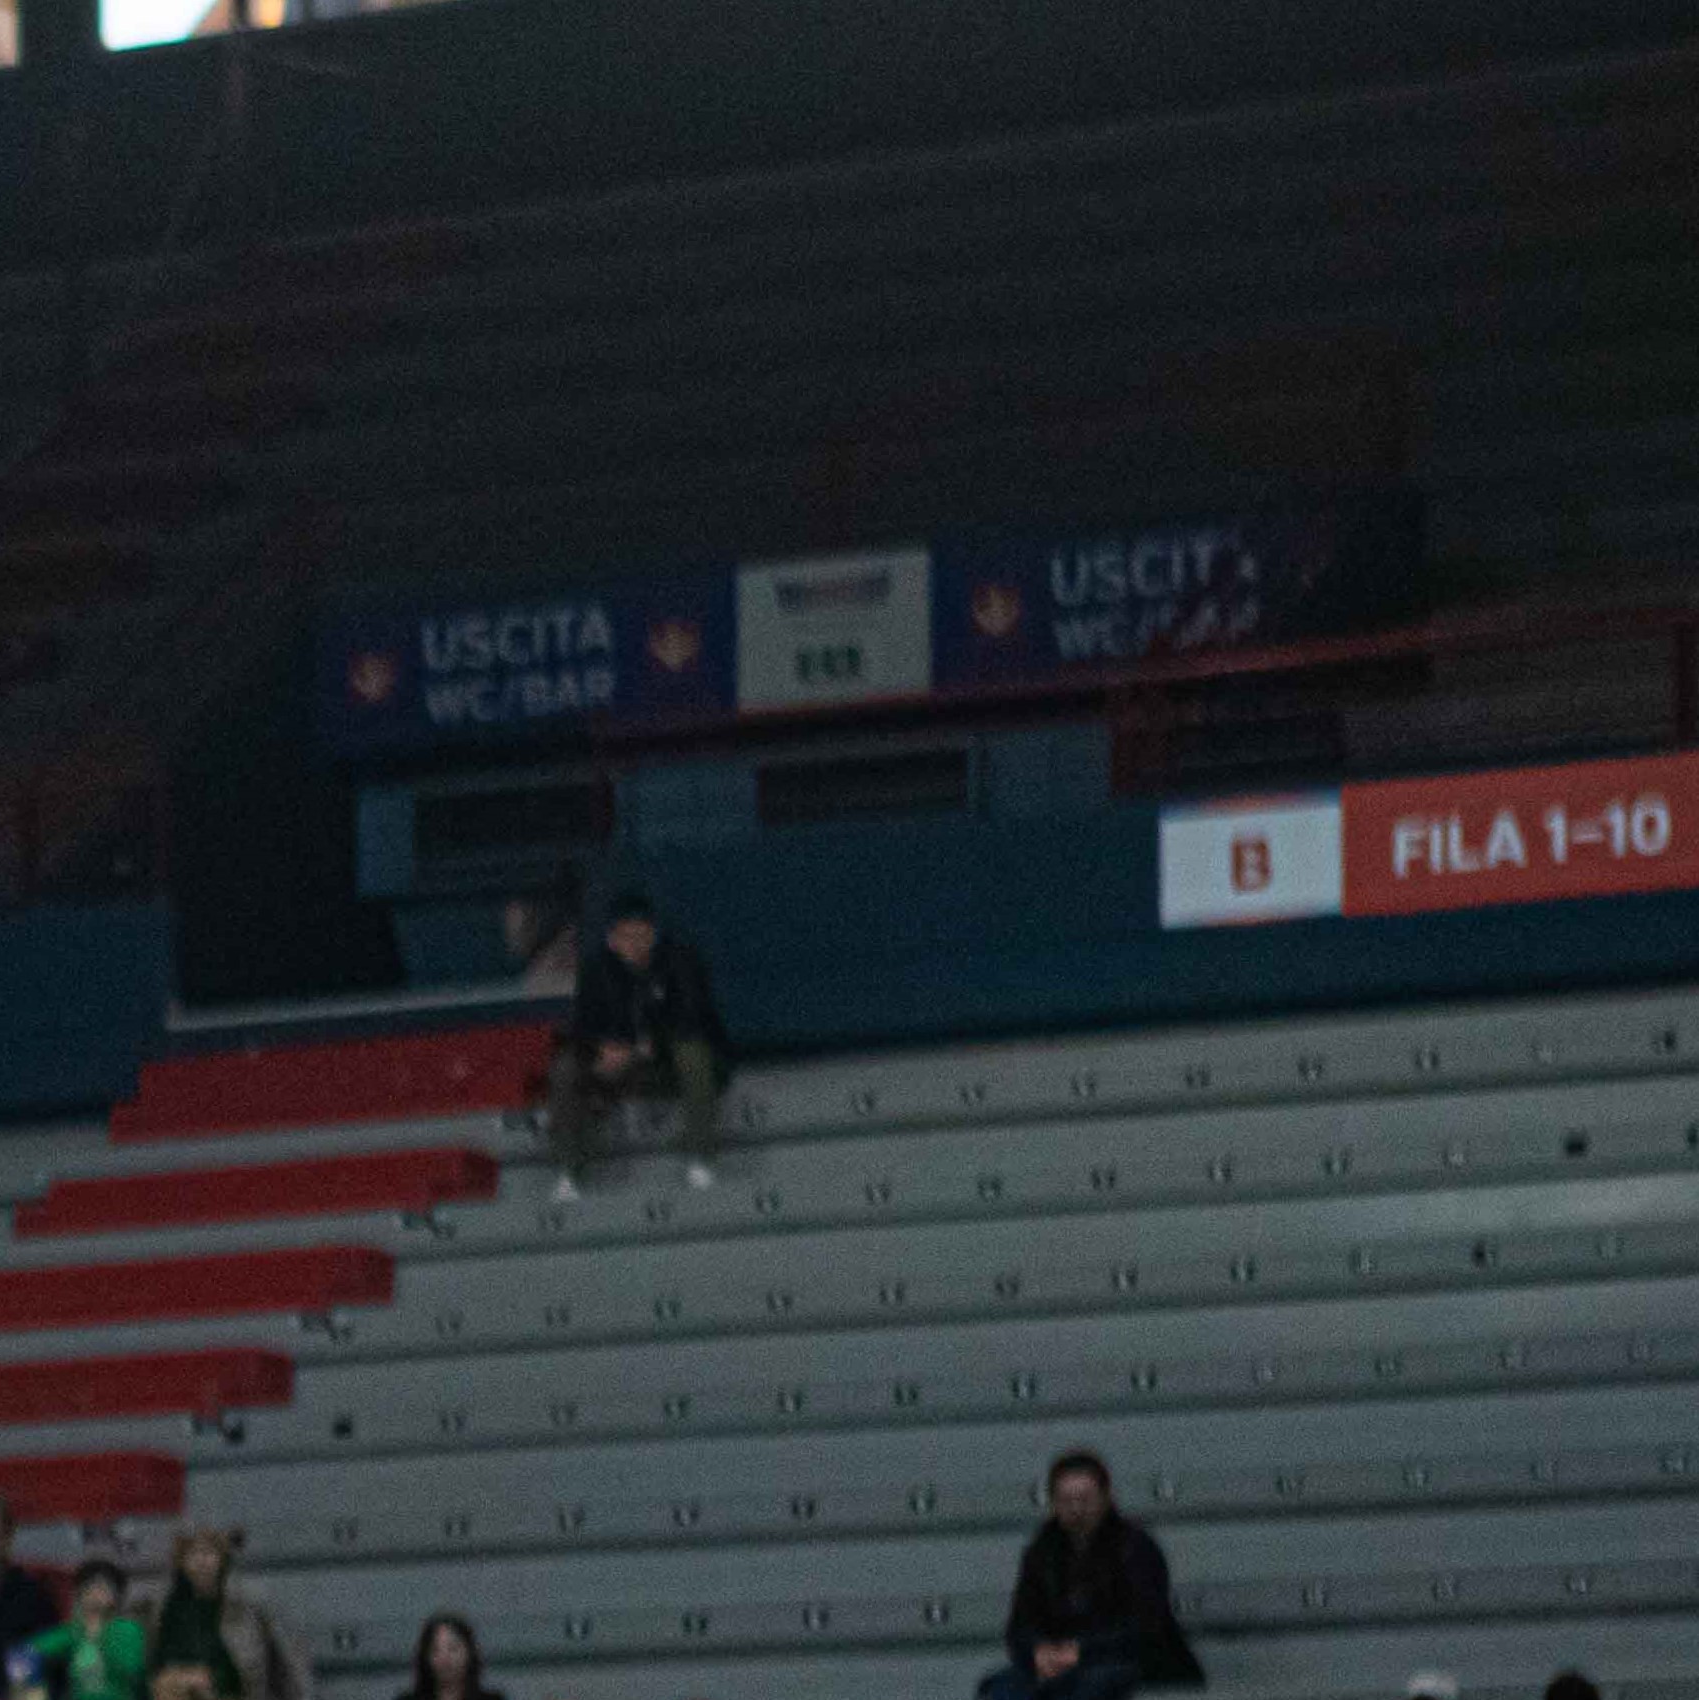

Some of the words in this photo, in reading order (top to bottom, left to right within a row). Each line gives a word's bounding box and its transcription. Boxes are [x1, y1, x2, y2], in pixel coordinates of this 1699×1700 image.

[421, 601, 615, 669] USCITA
[1230, 835, 1272, 892] B
[1392, 813, 1528, 879] FILA
[1546, 793, 1672, 864] 1-10
